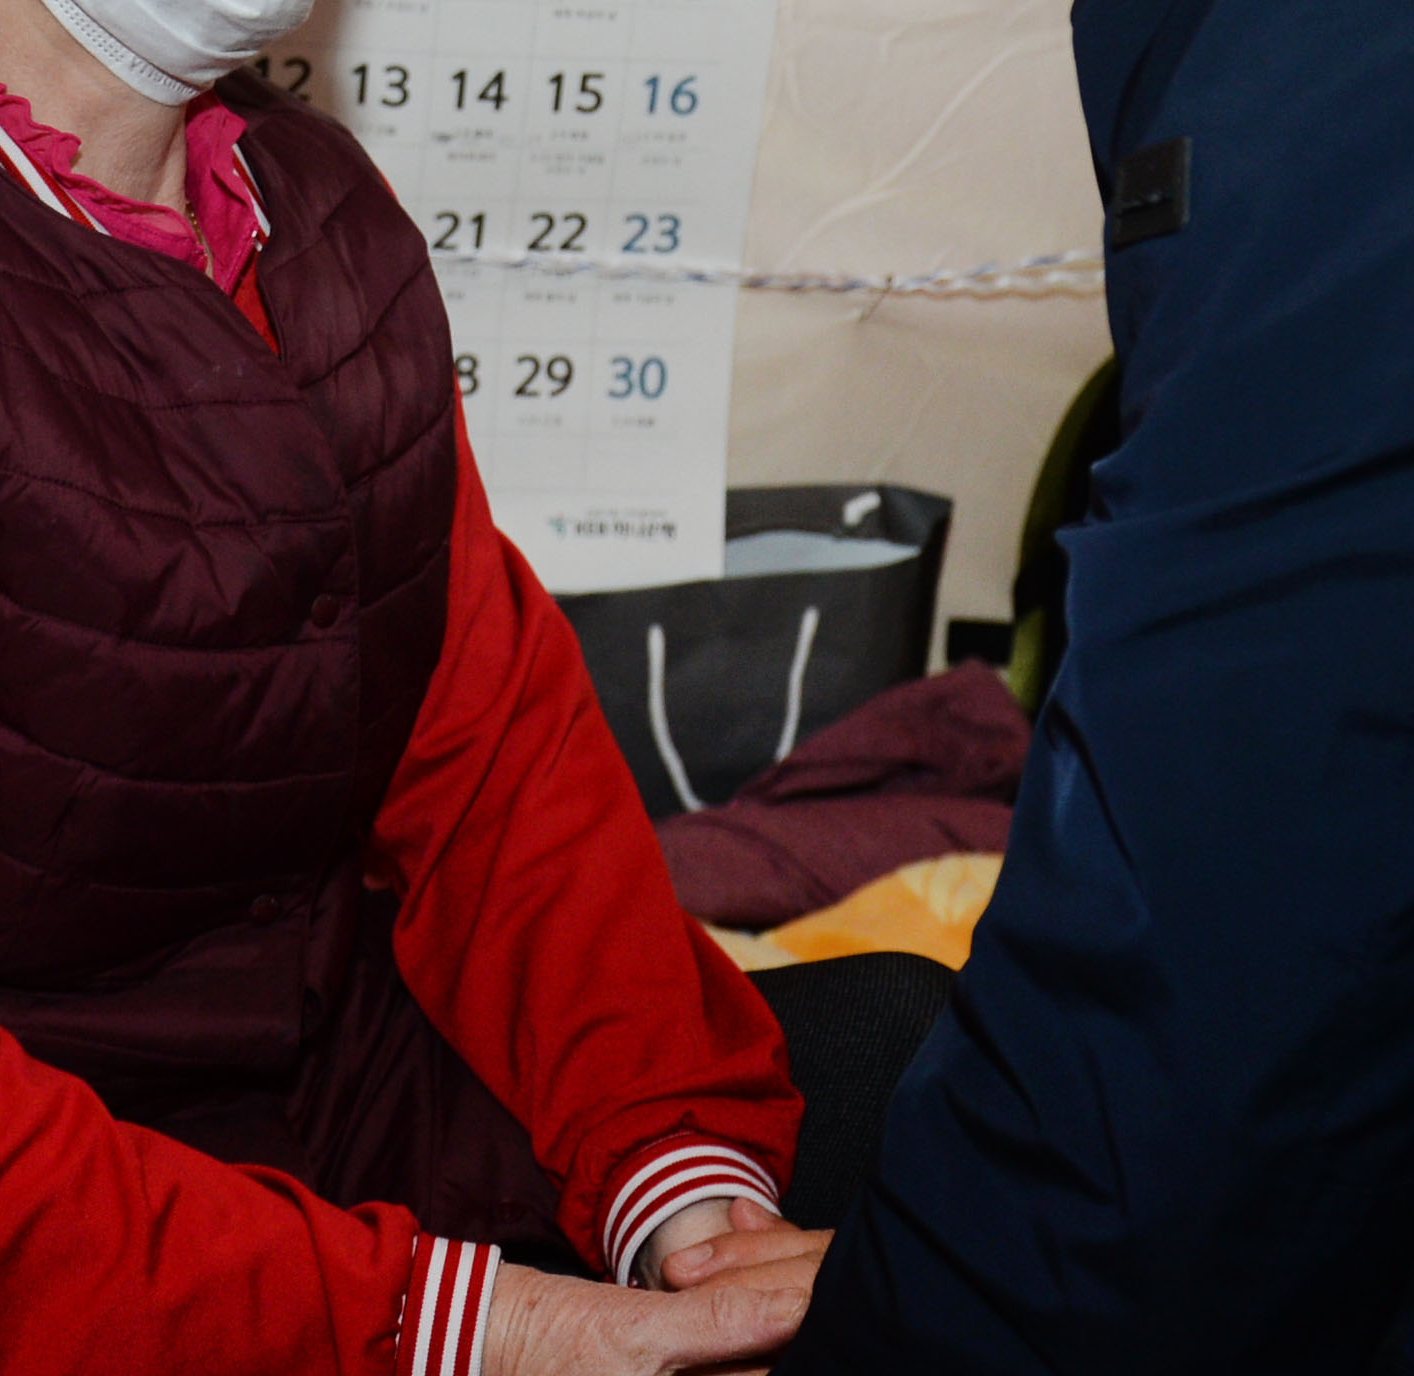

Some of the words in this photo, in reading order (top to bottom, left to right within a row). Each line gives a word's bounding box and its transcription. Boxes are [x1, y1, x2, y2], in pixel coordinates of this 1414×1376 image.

[352, 64, 410, 108] 13
[452, 69, 508, 111] 14
[548, 72, 604, 114] 15
[644, 75, 699, 116] 16
[434, 211, 486, 251] 21
[527, 212, 588, 252] 22
[621, 213, 681, 254] 23
[455, 353, 479, 397] 8
[514, 355, 574, 398] 29
[608, 356, 668, 400] 30
